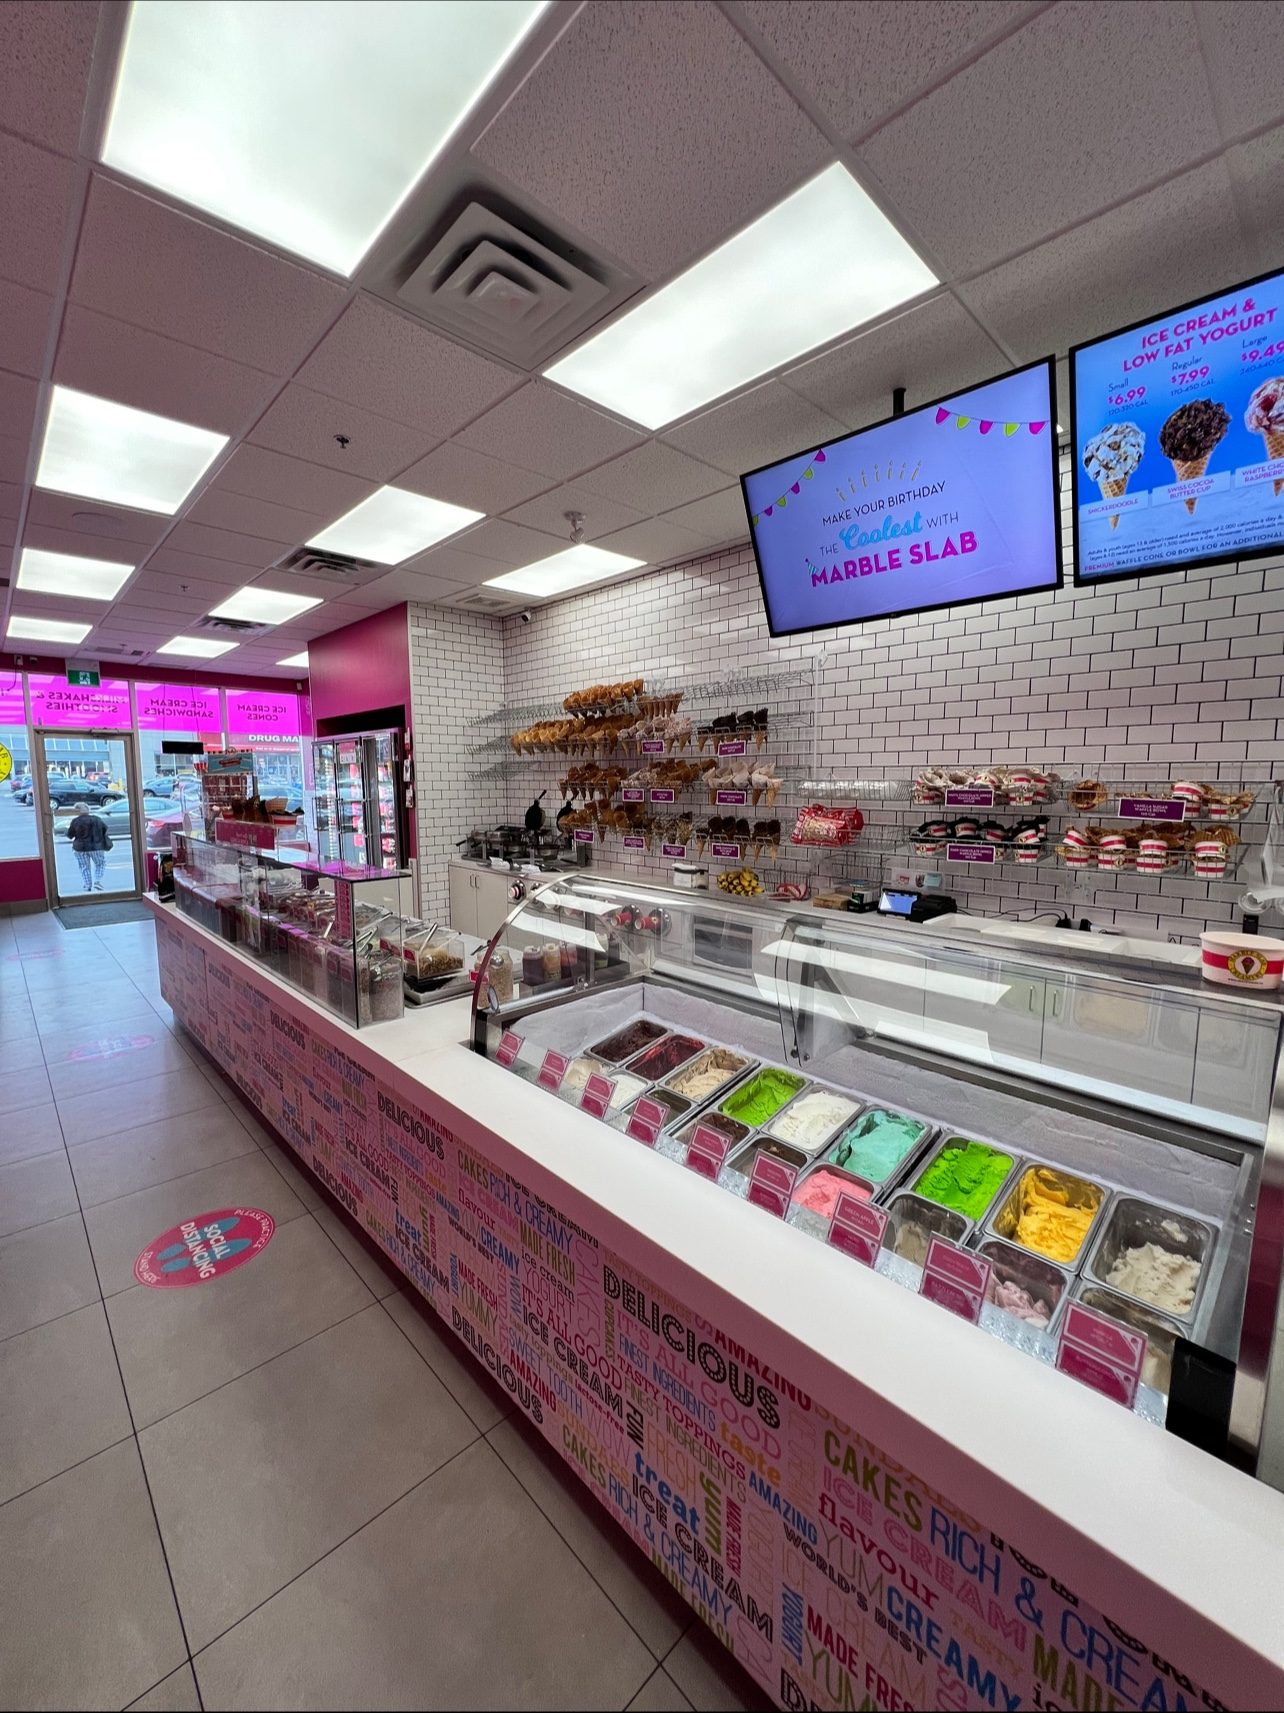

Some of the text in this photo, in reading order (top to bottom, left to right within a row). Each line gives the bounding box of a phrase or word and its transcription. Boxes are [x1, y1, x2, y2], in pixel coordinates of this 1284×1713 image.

[1123, 307, 1278, 373] LOW FAT YOGURT
[1141, 298, 1256, 350] ICE CREAM &
[1242, 336, 1267, 349] Large
[1108, 379, 1129, 393] Small
[1171, 366, 1210, 386] $7.99
[1172, 354, 1202, 372] Regular
[1108, 386, 1146, 406] $6.99
[1167, 478, 1214, 494] SWISS COCOA
[1169, 485, 1212, 499] BUTTER CUP
[1242, 466, 1266, 476] WHITE
[820, 511, 959, 557] THE Coolest WITH
[821, 481, 946, 526] MAKE YOUR BIRTHDAY
[811, 531, 978, 587] MARBLE SLAB
[1084, 562, 1115, 571] PREMIUM
[1143, 553, 1164, 561] CONE
[1178, 547, 1200, 555] BOWL
[1232, 531, 1283, 545] ADDITIONAL
[248, 734, 280, 742] DRUG
[270, 1009, 306, 1051] DELICIOUS
[377, 1091, 445, 1161] DELICIOUS
[313, 1155, 358, 1217] DELICIOUS
[345, 1139, 390, 1190] ICE CREAM
[368, 1144, 389, 1173] GOOD
[416, 1144, 446, 1178] GOOD
[234, 1208, 264, 1222] PLEASE
[390, 1175, 399, 1206] FUN
[404, 1165, 436, 1199] TOPPINGS
[435, 1192, 460, 1221] AMAZING
[457, 1149, 490, 1190] CAKES
[513, 1193, 523, 1216] &
[525, 1201, 574, 1256] CREAMY
[458, 1189, 496, 1231] flavour
[844, 1206, 860, 1219] GREEN
[861, 1214, 874, 1226] APPLE
[180, 1221, 216, 1279] DISTANCING
[203, 1223, 231, 1260] SOCIAL
[365, 1209, 387, 1242] CAKES
[394, 1207, 422, 1244] treat
[448, 1214, 495, 1264] WORLD'S BEST
[459, 1208, 520, 1275] YUM CREAMY
[519, 1220, 576, 1287] MADE FRESH
[394, 1224, 451, 1295] ICE CREAM
[458, 1259, 498, 1312] MADE FRESH
[521, 1249, 576, 1304] ice cream
[459, 1281, 498, 1337] YUMMY
[522, 1262, 576, 1324] YOGURT
[574, 1239, 601, 1349] CAKES
[451, 1304, 544, 1425] DELICIOUS
[521, 1283, 622, 1391] IT'S ALL GOOD
[522, 1306, 549, 1347] ICE
[553, 1336, 624, 1419] CREAM
[603, 1264, 781, 1430] DELICIOUS
[508, 1326, 542, 1376] SWEET
[546, 1361, 584, 1420] TOOTH
[509, 1348, 557, 1413] AMAZING
[616, 1310, 782, 1460] IT'S ALL GOOD
[619, 1332, 717, 1433] FINEST INGREDIENTS
[574, 1377, 625, 1435] lactose-free
[585, 1401, 632, 1467] WOW
[617, 1353, 746, 1481] TASTY TOPPINGS
[626, 1402, 644, 1450] FUN
[624, 1377, 662, 1424] FINEST
[665, 1419, 748, 1504] INGREDIENTS
[647, 1421, 698, 1507] FRESH
[720, 1422, 781, 1488] taste
[563, 1423, 734, 1626] CAKES RICH & CREAMY
[634, 1451, 701, 1537] treat
[699, 1471, 722, 1557] yum
[748, 1470, 819, 1547] AMAZING
[631, 1472, 669, 1531] ICE
[673, 1522, 773, 1644] CREAM
[818, 1491, 940, 1613] flavour
[823, 1465, 874, 1527] ICE
[883, 1518, 1028, 1652] CREAM
[824, 1429, 923, 1534] CAKES
[930, 1504, 1001, 1597] RICH
[1014, 1575, 1045, 1632] &
[781, 1581, 805, 1667] YOGURT
[782, 1521, 870, 1614] WORLD'S
[874, 1605, 928, 1666] BEST
[818, 1518, 884, 1606] YUM
[886, 1584, 1023, 1712] CREAMY
[807, 1604, 859, 1680] MADE
